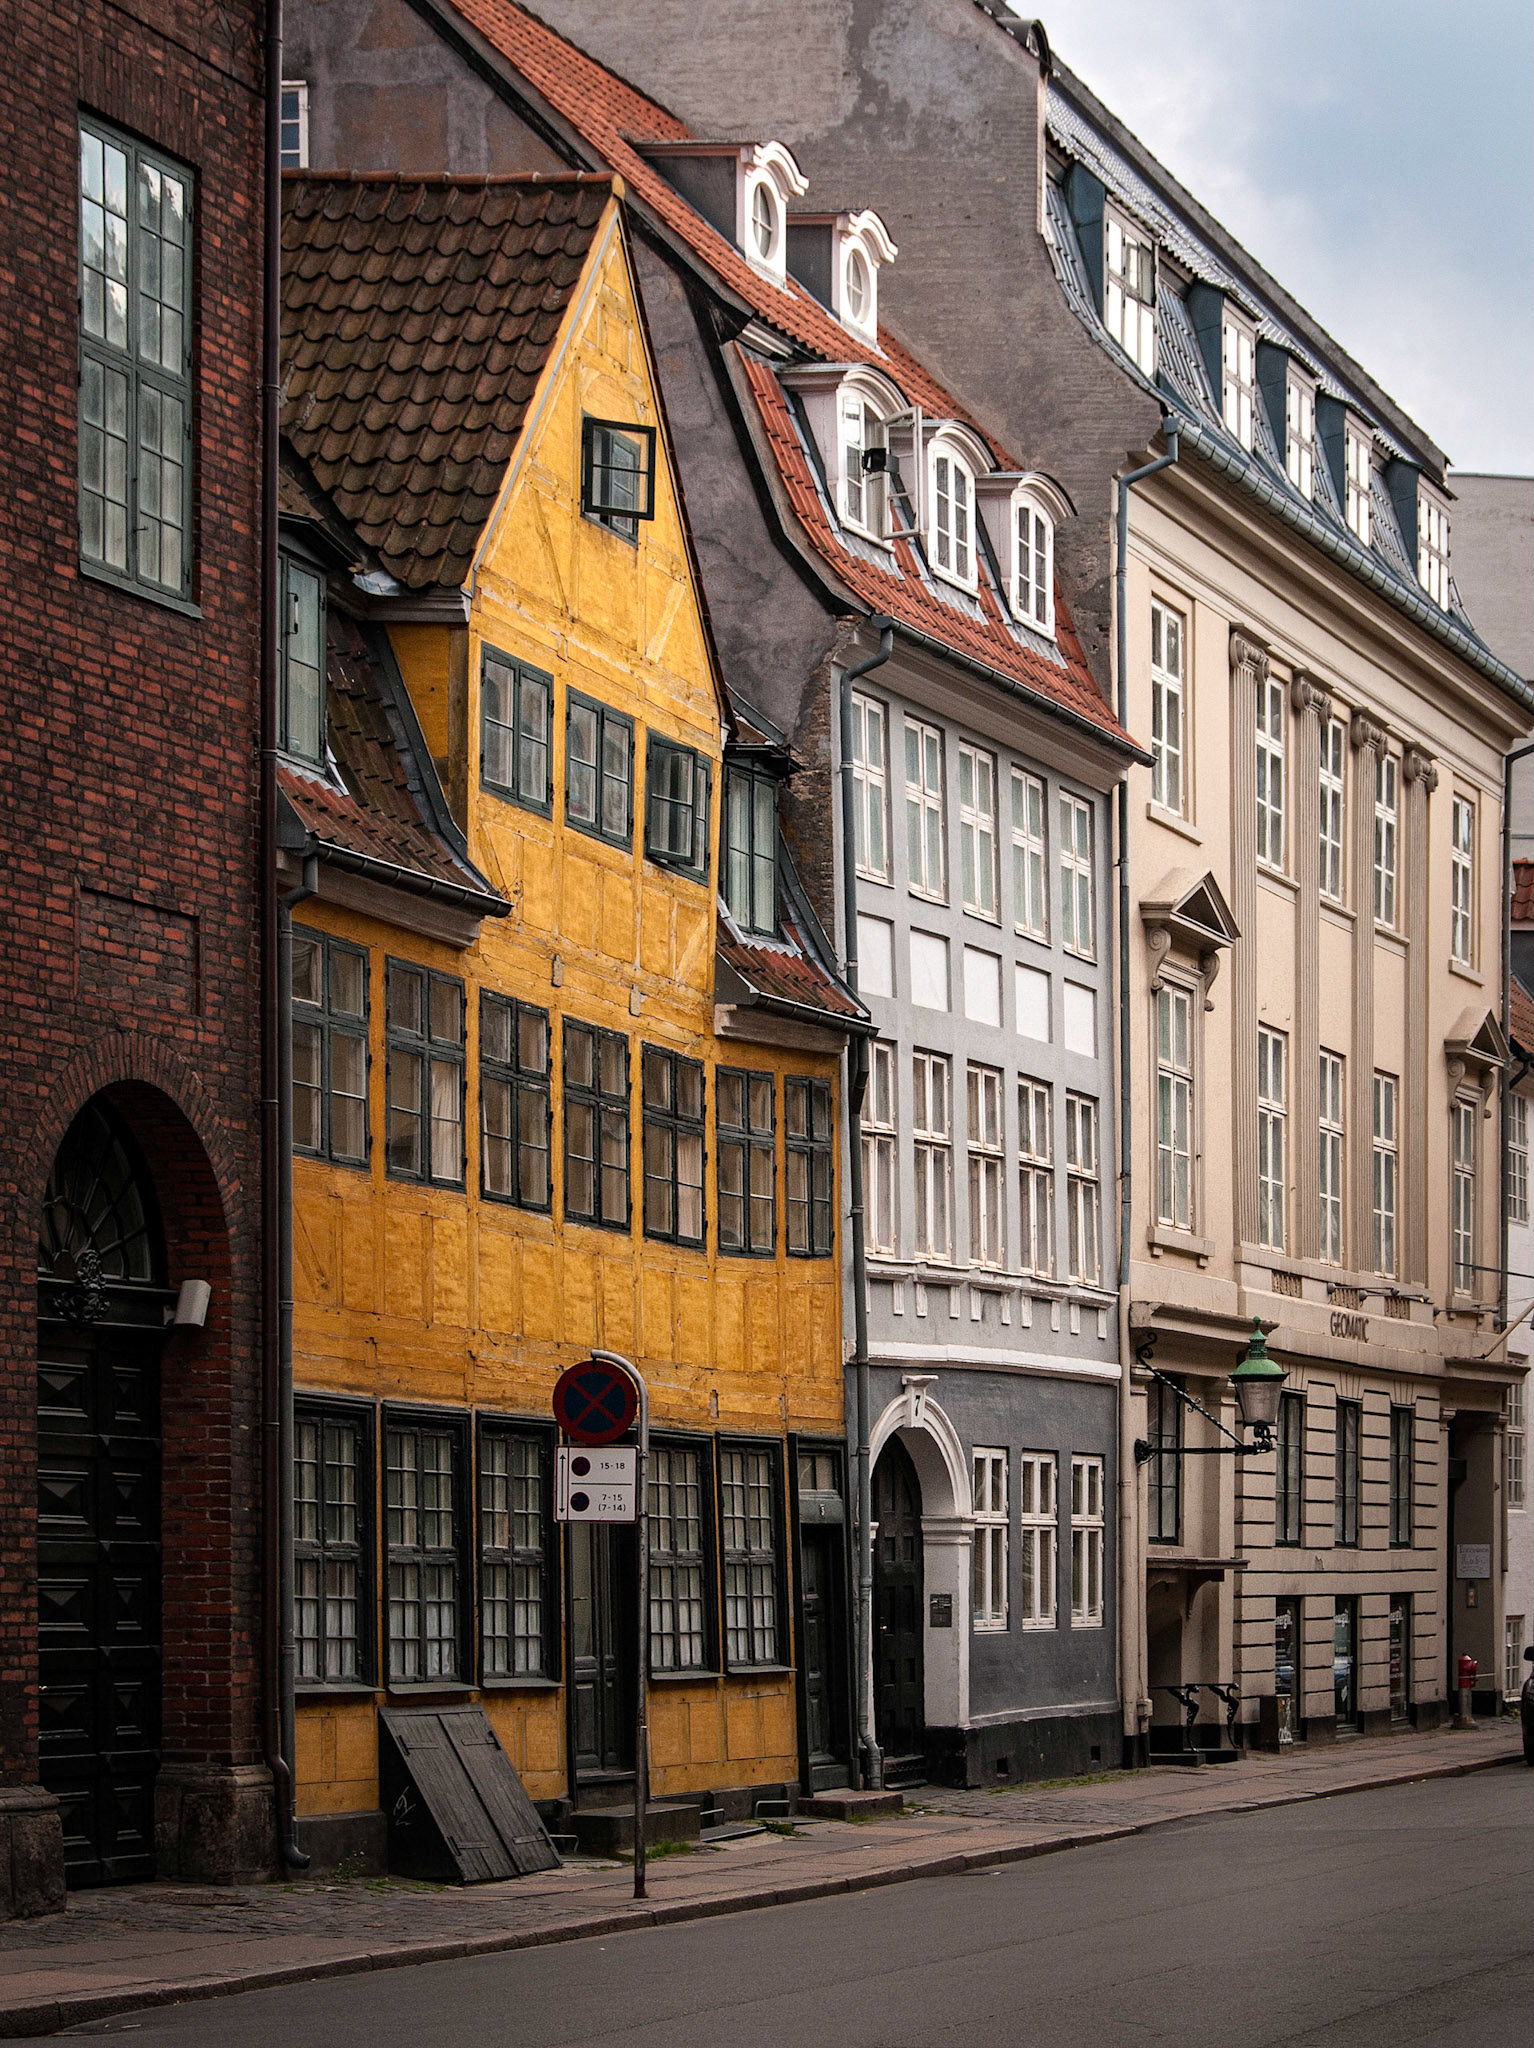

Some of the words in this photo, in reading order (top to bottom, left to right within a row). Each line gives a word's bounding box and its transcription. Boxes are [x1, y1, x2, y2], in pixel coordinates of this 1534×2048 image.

[1330, 1311, 1369, 1343] GEOMATIC
[915, 1394, 921, 1417] 7
[600, 1462, 625, 1470] 15-18
[601, 1493, 623, 1501] 7-15
[598, 1503, 626, 1512] (7-14)
